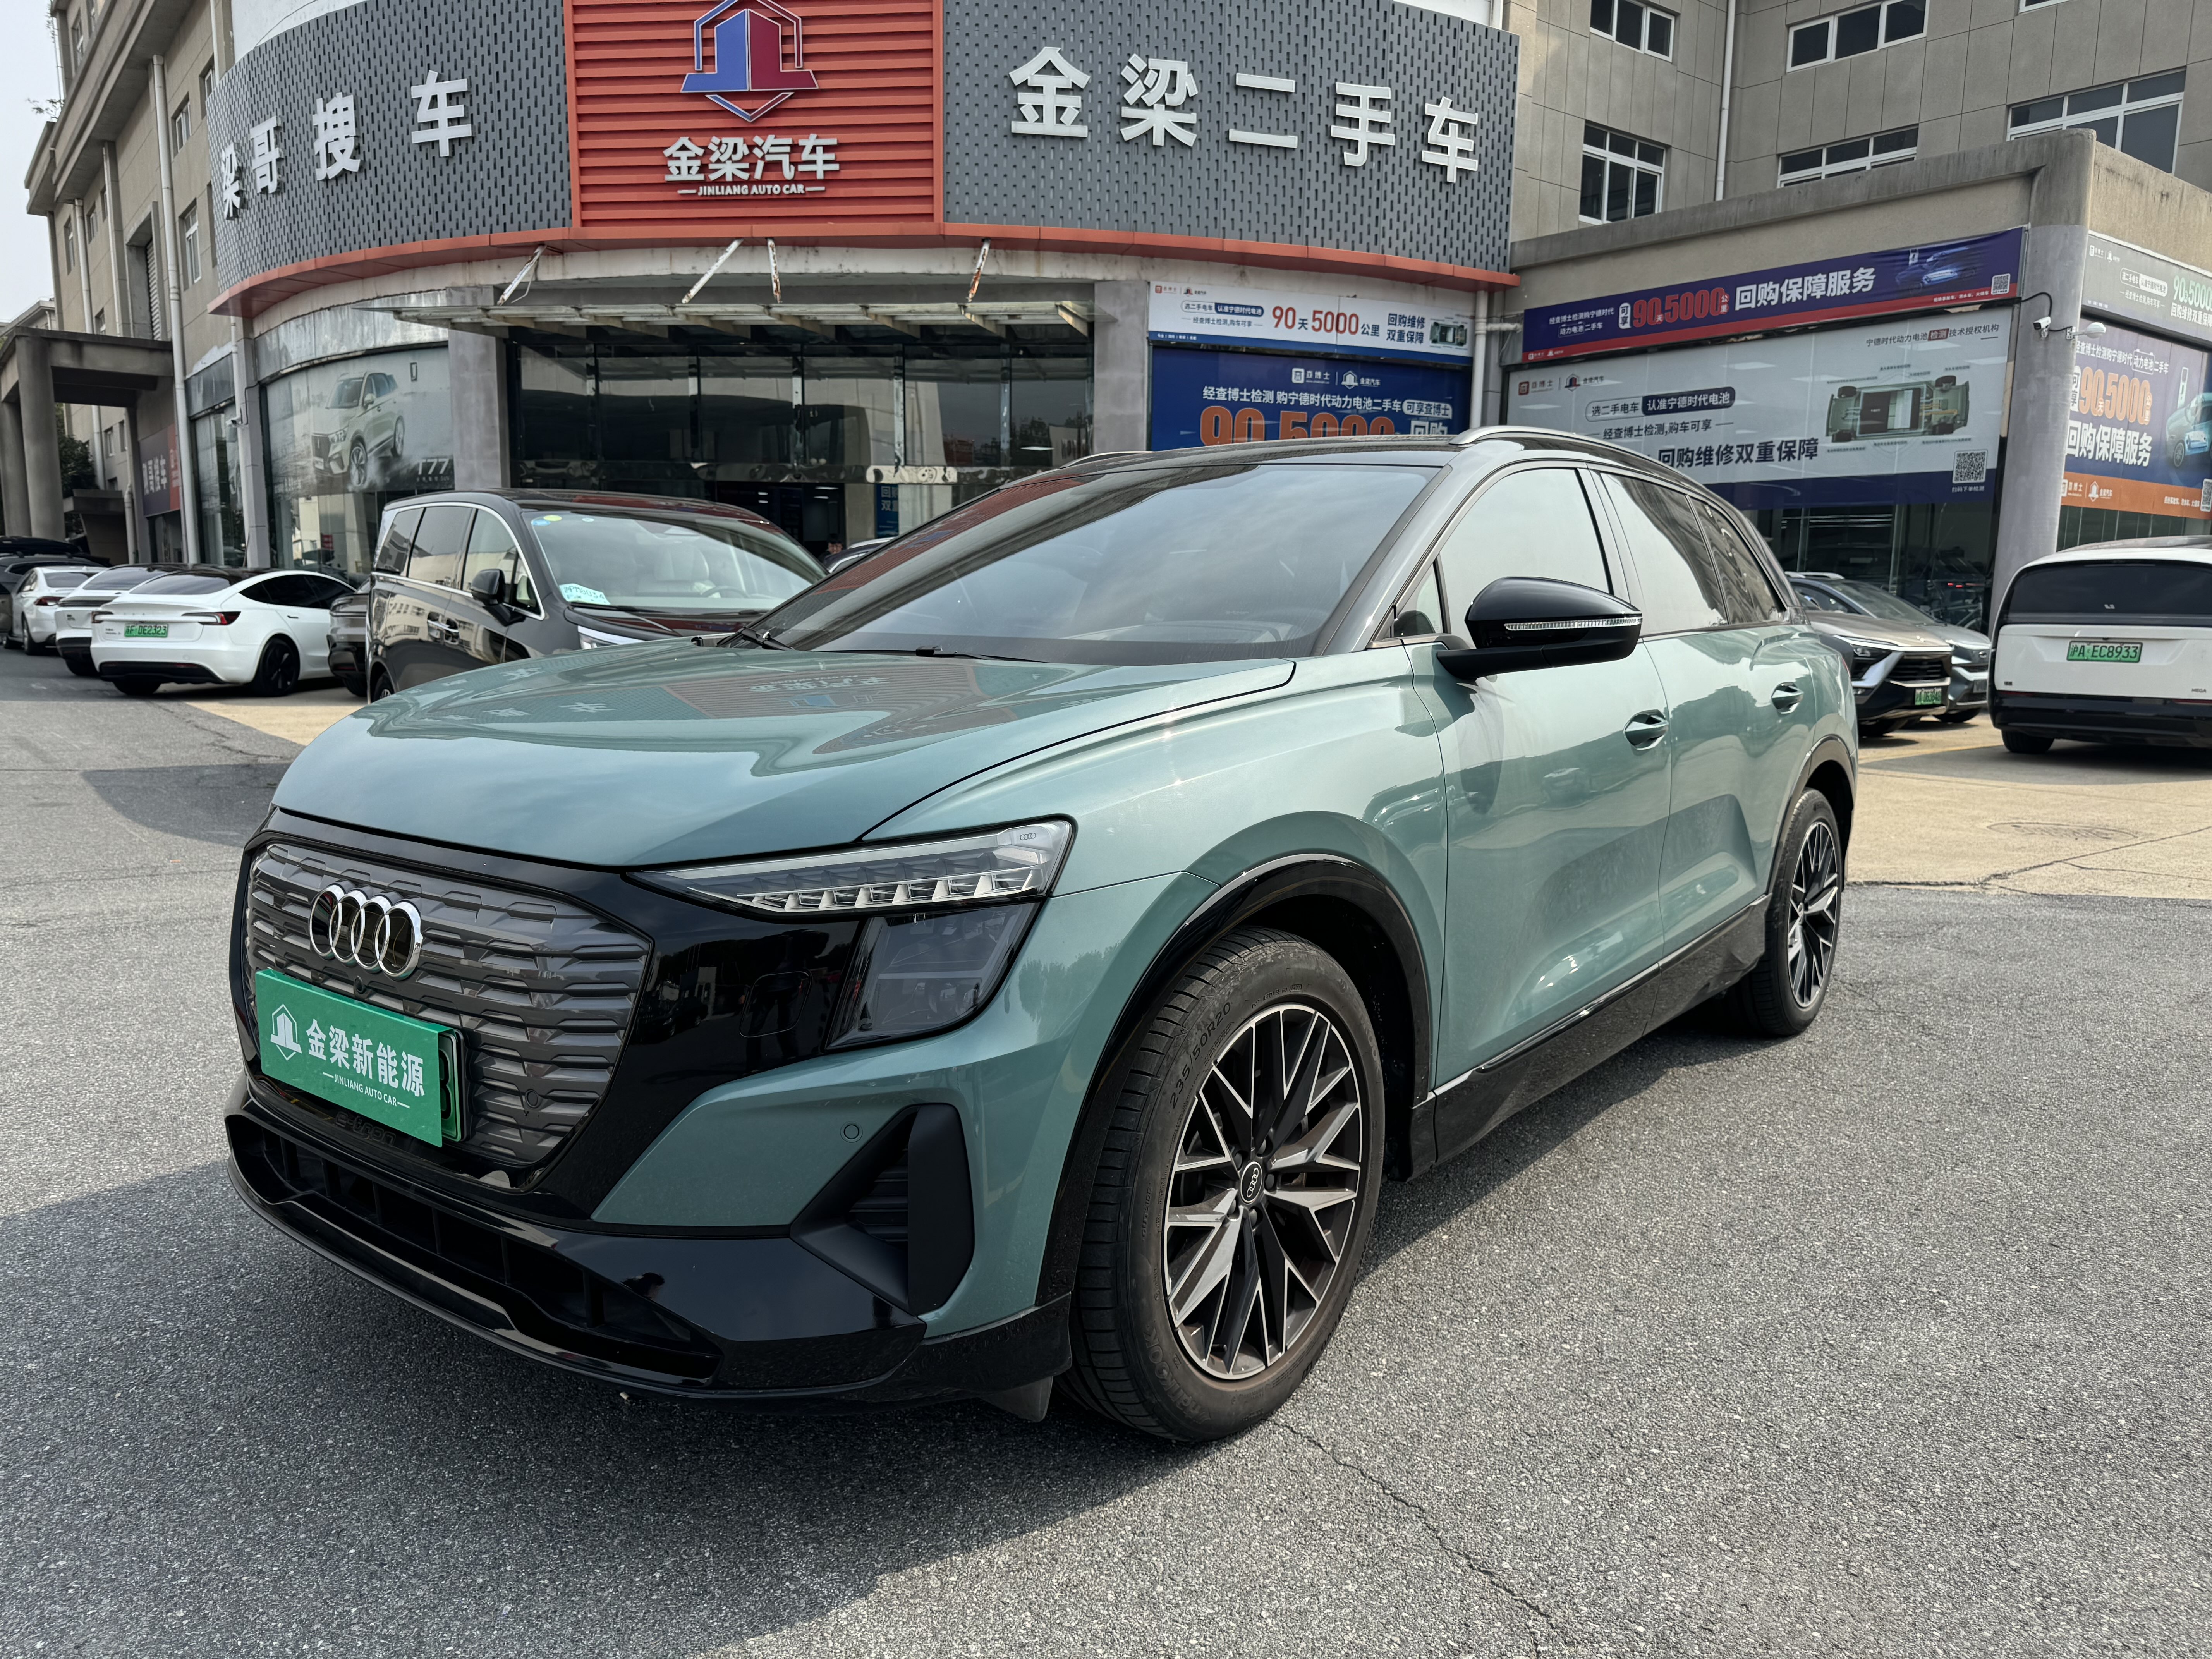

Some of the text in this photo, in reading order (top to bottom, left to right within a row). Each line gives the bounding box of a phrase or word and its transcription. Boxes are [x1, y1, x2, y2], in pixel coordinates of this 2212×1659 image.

[1009, 46, 1479, 183] 金梁二手车
[221, 70, 472, 218] 梁哥搜车
[663, 134, 839, 182] 金梁汽车
[697, 184, 805, 196] JINLIANG AUTO CAR
[1735, 267, 1876, 311] 回购保障服务
[1386, 330, 1424, 344] 双重保障
[1388, 313, 1425, 328] 回购维修
[1592, 392, 1730, 417] 选二手电车 认准宁德时代电池
[2066, 420, 2152, 467] 回购保障服务
[306, 1019, 425, 1097] 金梁新能源
[1170, 1002, 1231, 1109] 235/50R20
[334, 1074, 398, 1107] JINLIANG AUTO CAR
